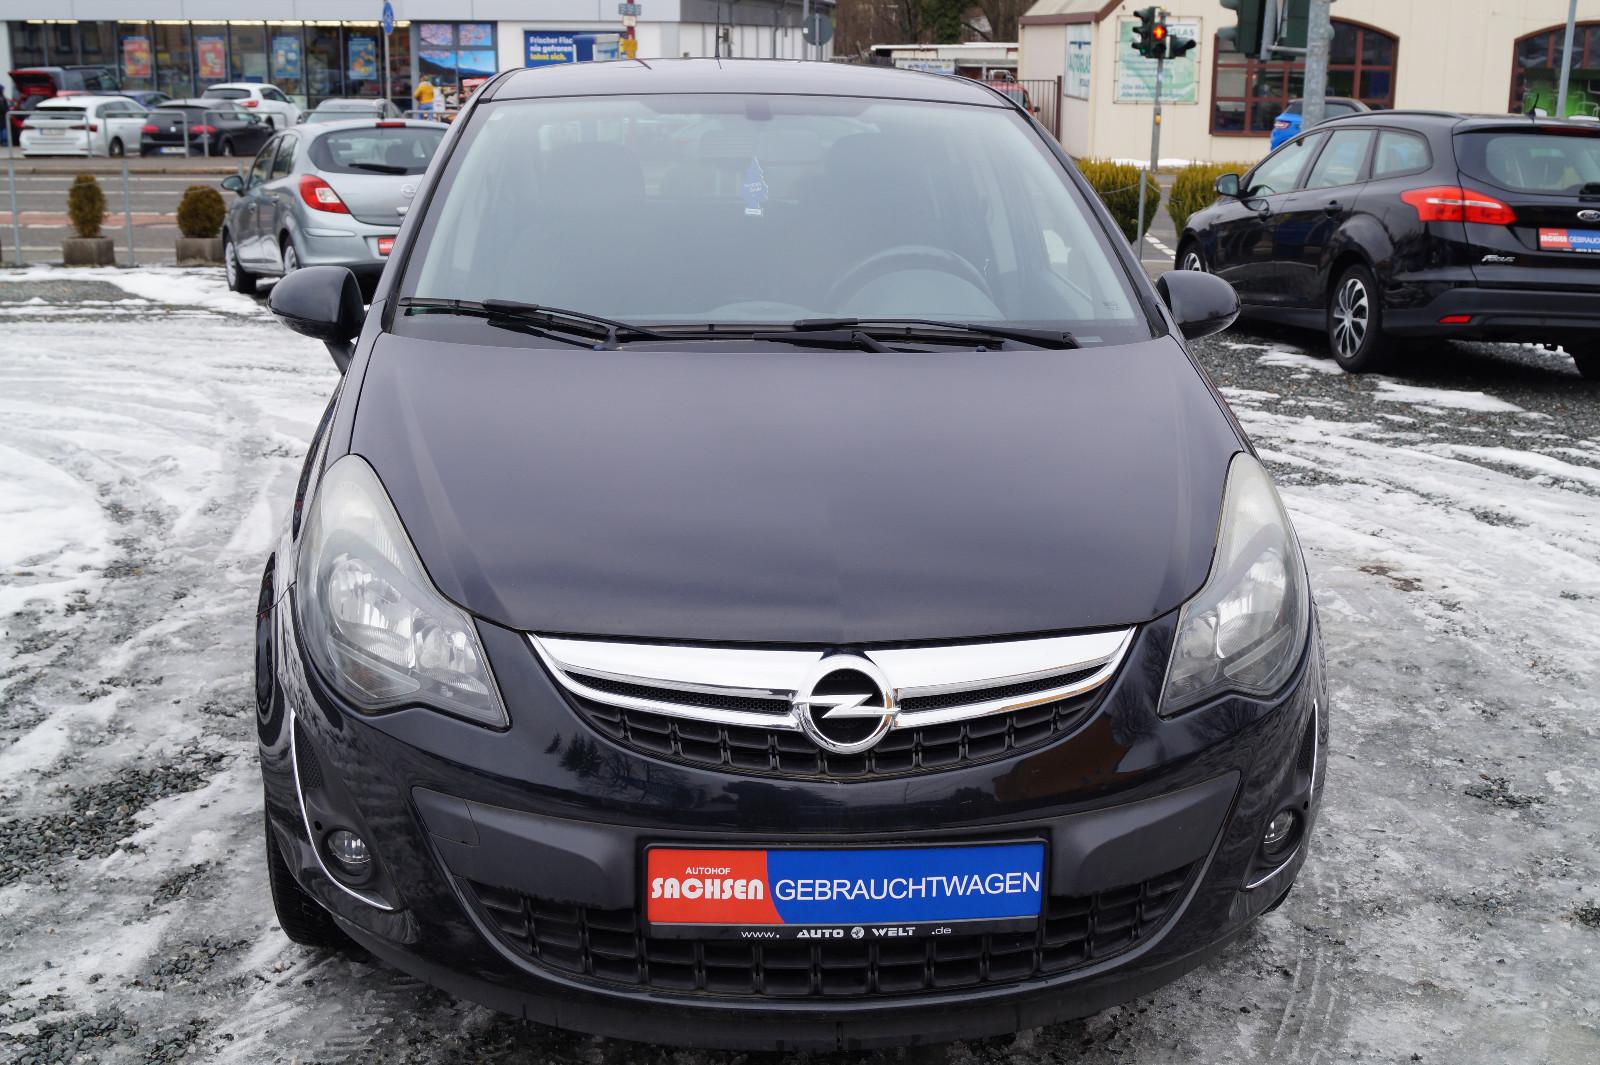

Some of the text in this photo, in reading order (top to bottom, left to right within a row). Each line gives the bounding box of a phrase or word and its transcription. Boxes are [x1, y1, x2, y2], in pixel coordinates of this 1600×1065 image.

[529, 36, 574, 44] Frischer Fisc
[543, 45, 573, 53] gefroren
[685, 866, 731, 875] AUTOHOF
[651, 877, 764, 900] SACHSEN
[775, 871, 1041, 901] GEBRAUCHTWAGEN
[796, 929, 844, 938] AUTO
[871, 927, 916, 937] WELT
[931, 926, 952, 936] .de
